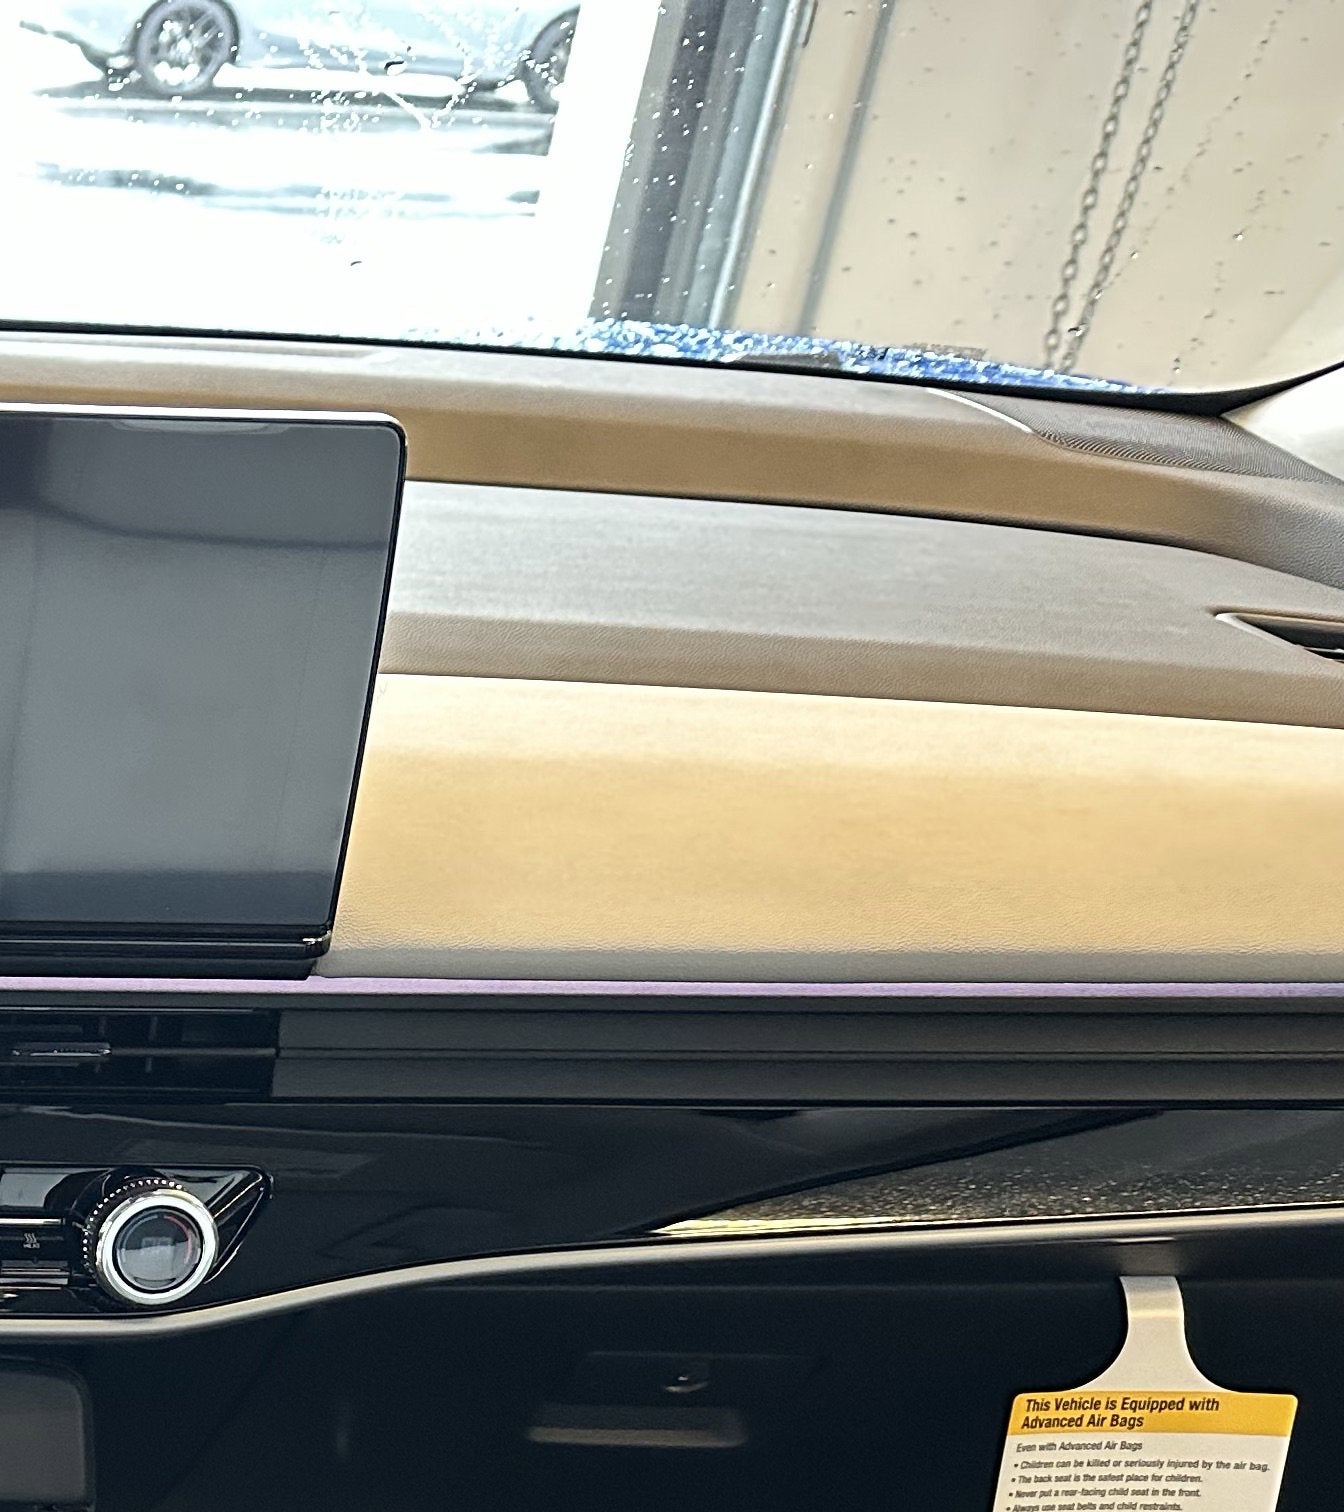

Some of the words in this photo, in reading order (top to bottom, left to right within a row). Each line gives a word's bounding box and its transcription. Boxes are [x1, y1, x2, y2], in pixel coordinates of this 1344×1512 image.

[1025, 1398, 1051, 1412] This
[1054, 1397, 1102, 1411] Vehicle
[1104, 1397, 1118, 1411] is
[1120, 1397, 1186, 1413] Equipped
[1189, 1397, 1220, 1411] with
[1021, 1414, 1084, 1429] Advanced
[1086, 1414, 1108, 1428] Air
[1110, 1413, 1145, 1430] Bags
[1016, 1443, 1037, 1453] Even
[1038, 1442, 1057, 1451] with
[1058, 1441, 1103, 1451] Advanced
[1104, 1441, 1118, 1450] Air
[1120, 1441, 1143, 1452] Bags
[1020, 1460, 1054, 1469] Children
[1073, 1460, 1084, 1468] be
[1086, 1459, 1110, 1467] killed
[1112, 1460, 1122, 1468] or
[1123, 1459, 1164, 1469] seriously
[1166, 1459, 1199, 1469] injured
[1201, 1460, 1213, 1470] by
[1215, 1460, 1231, 1469] the
[1233, 1461, 1247, 1470] air
[1249, 1462, 1271, 1472] bag.
[1018, 1475, 1032, 1484] The
[1033, 1475, 1052, 1483] back
[1054, 1474, 1072, 1482] seat
[1073, 1474, 1081, 1482] is
[1125, 1473, 1149, 1482] place
[1151, 1474, 1163, 1482] for
[1015, 1490, 1037, 1498] Never
[1039, 1489, 1052, 1499] put
[1108, 1488, 1129, 1496] child
[1130, 1488, 1149, 1496] seat
[1151, 1488, 1160, 1496] in
[1162, 1488, 1176, 1496] the
[1012, 1504, 1040, 1512] Always
[1057, 1503, 1076, 1511] seat
[1076, 1502, 1097, 1511] belts
[1098, 1502, 1115, 1510] and
[1117, 1502, 1137, 1510] child
